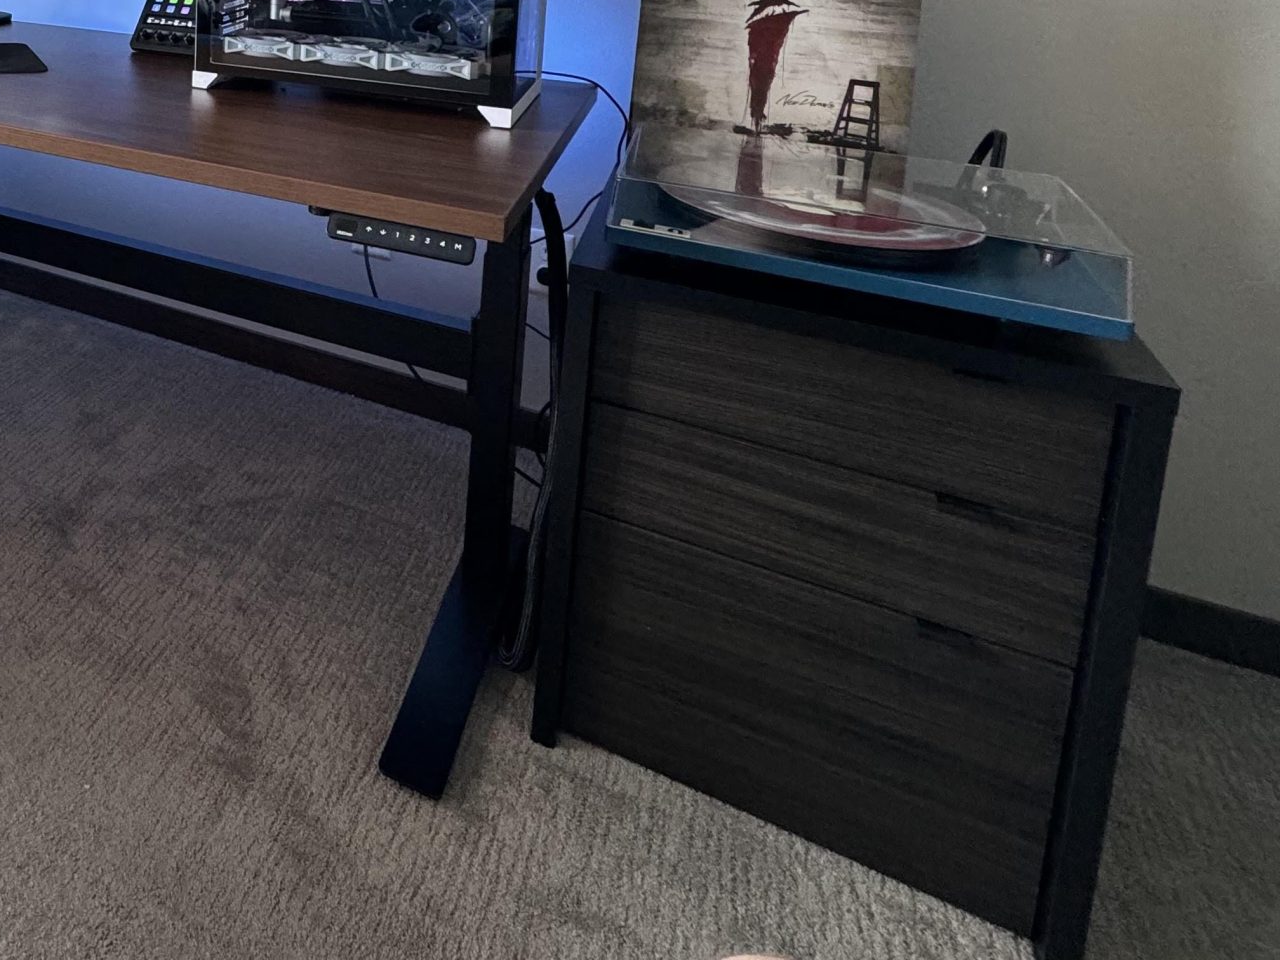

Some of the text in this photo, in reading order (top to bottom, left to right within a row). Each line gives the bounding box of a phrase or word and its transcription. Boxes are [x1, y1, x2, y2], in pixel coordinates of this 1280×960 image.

[409, 234, 416, 242] 2
[424, 237, 431, 245] 3
[454, 243, 462, 251] M
